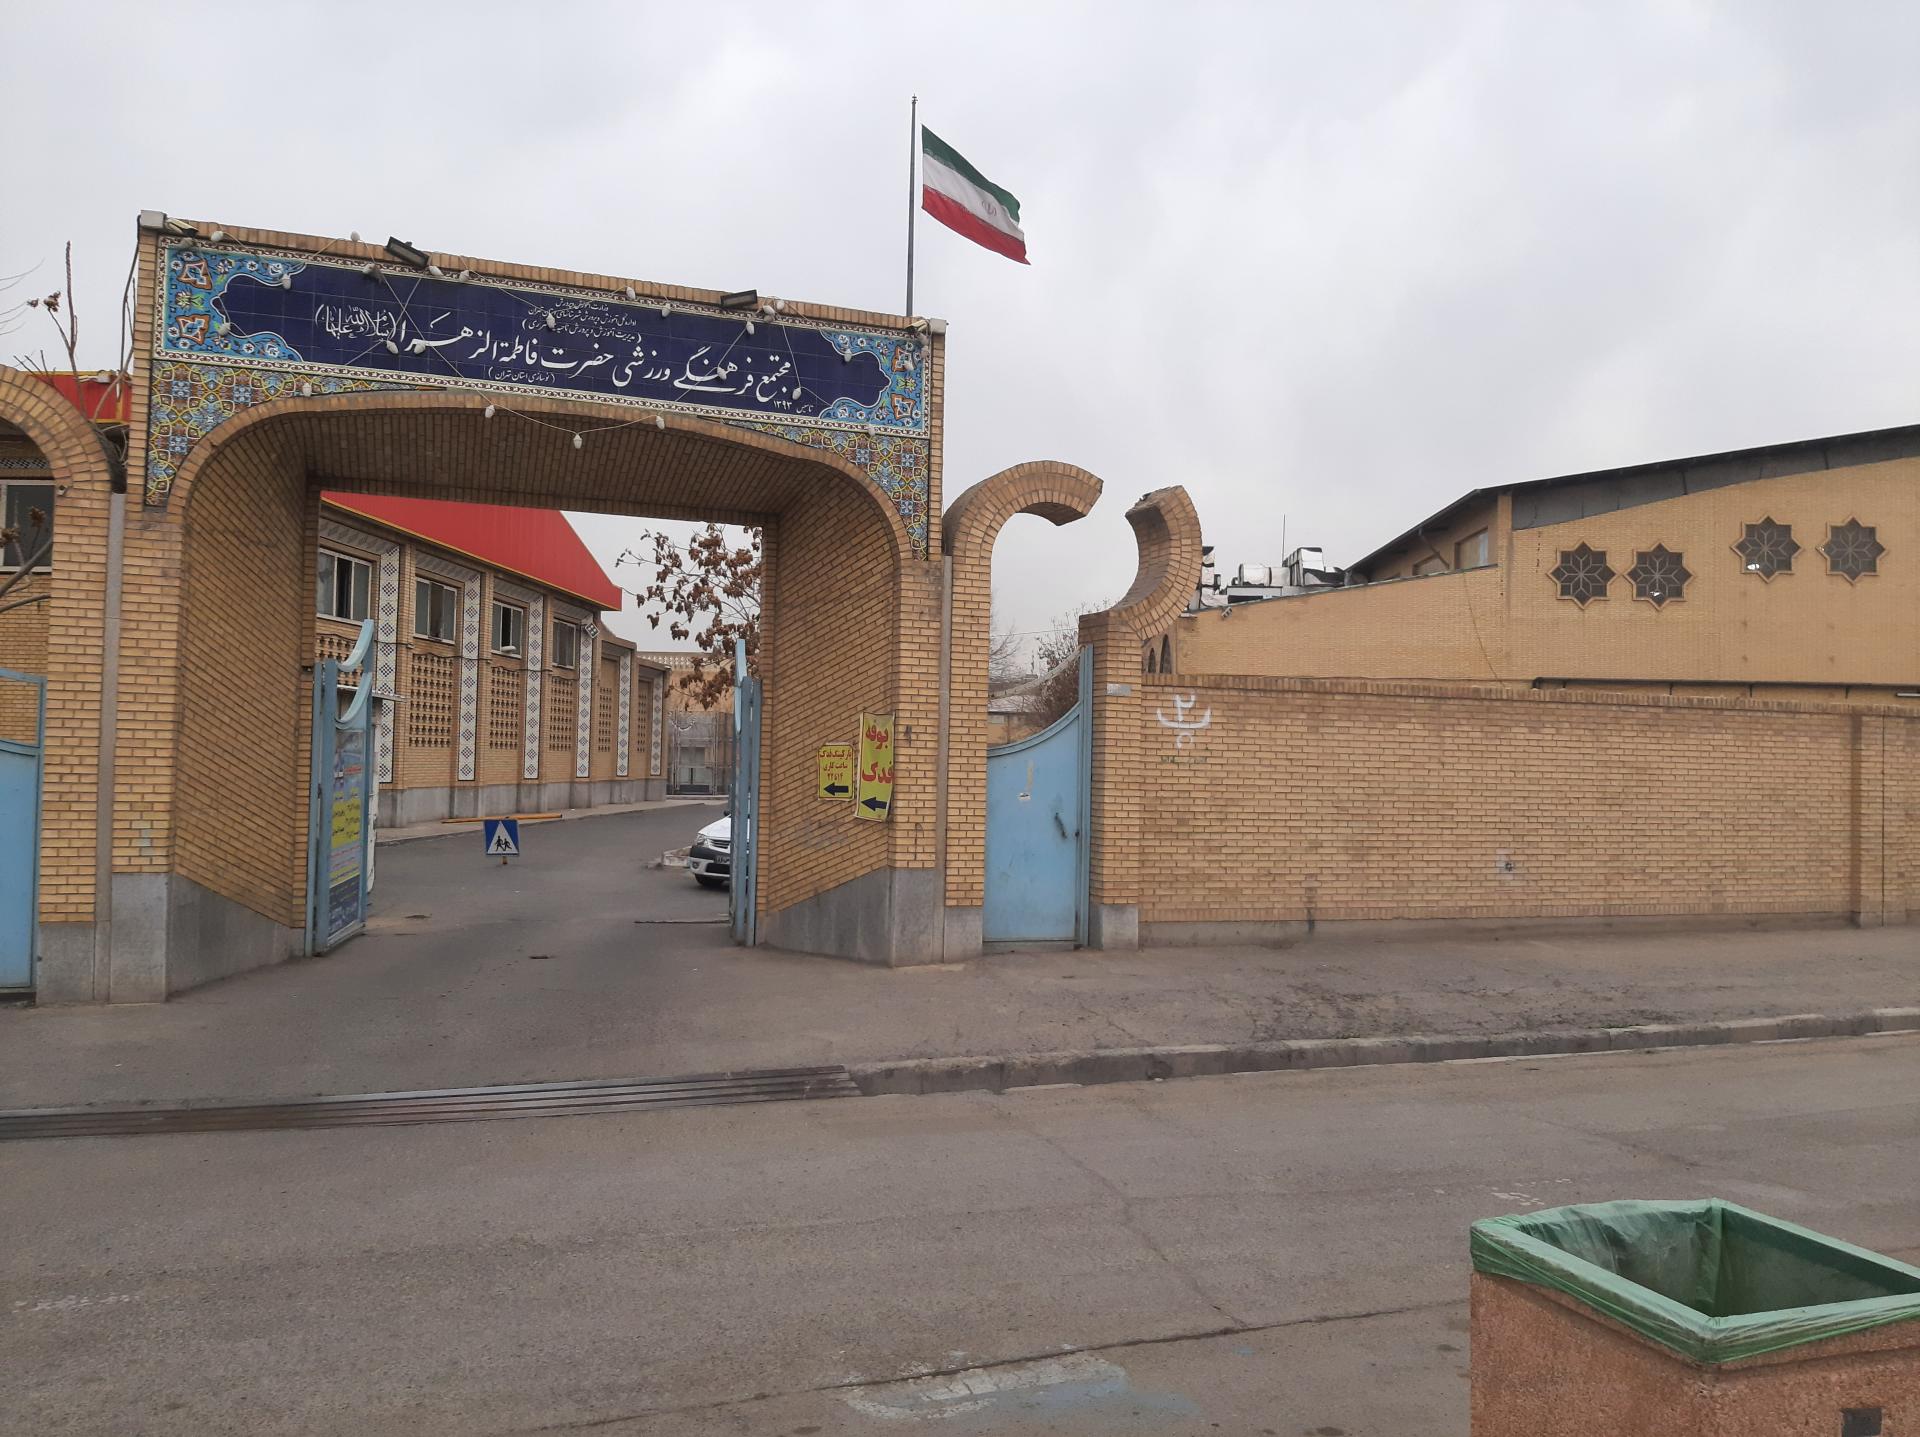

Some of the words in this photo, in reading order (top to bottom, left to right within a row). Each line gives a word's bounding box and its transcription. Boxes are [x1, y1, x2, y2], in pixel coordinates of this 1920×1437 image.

[511, 371, 528, 381] استان
[540, 343, 614, 379] حضرت
[611, 345, 671, 387] ورزشی
[755, 353, 792, 402] مجتمع
[866, 719, 889, 750] بوفه
[861, 760, 895, 784] فدک
